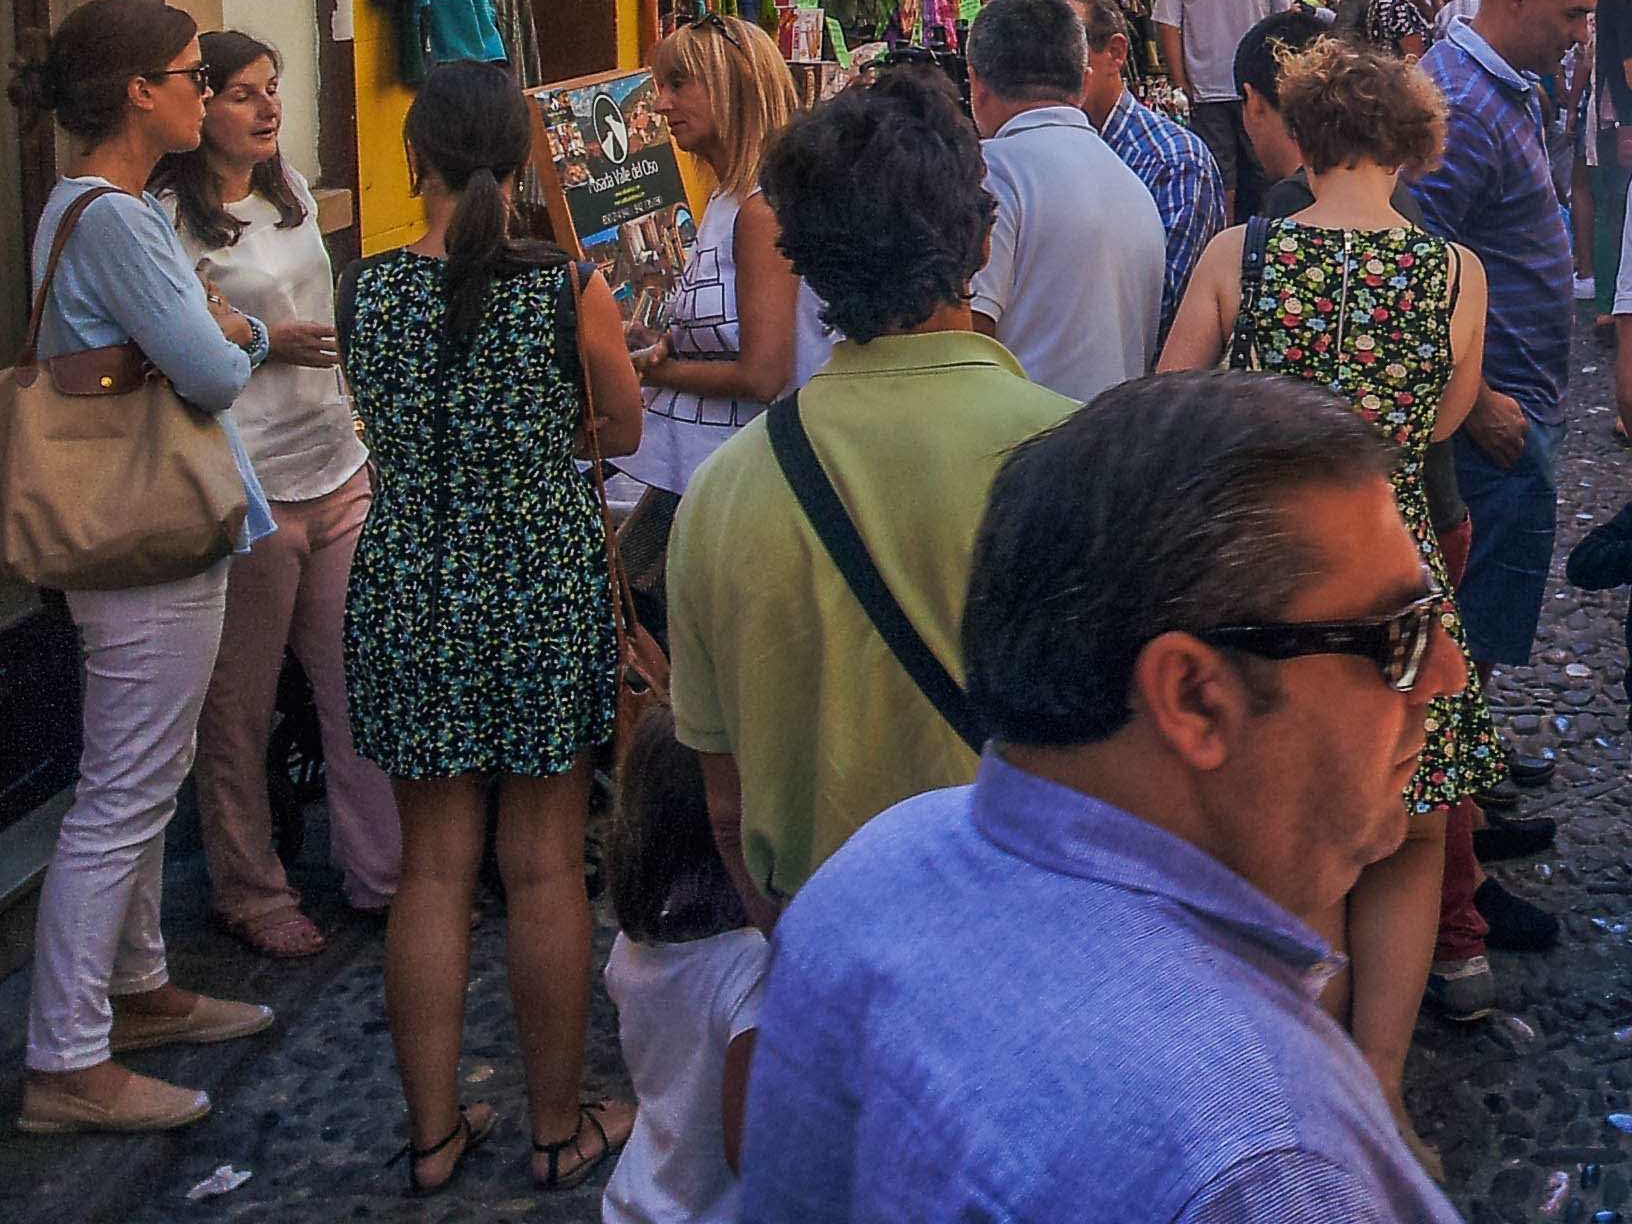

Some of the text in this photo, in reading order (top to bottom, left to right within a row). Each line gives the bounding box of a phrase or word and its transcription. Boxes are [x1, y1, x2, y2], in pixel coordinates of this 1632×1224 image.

[612, 166, 632, 185] Valle
[631, 160, 644, 180] del
[641, 159, 659, 176] Oso
